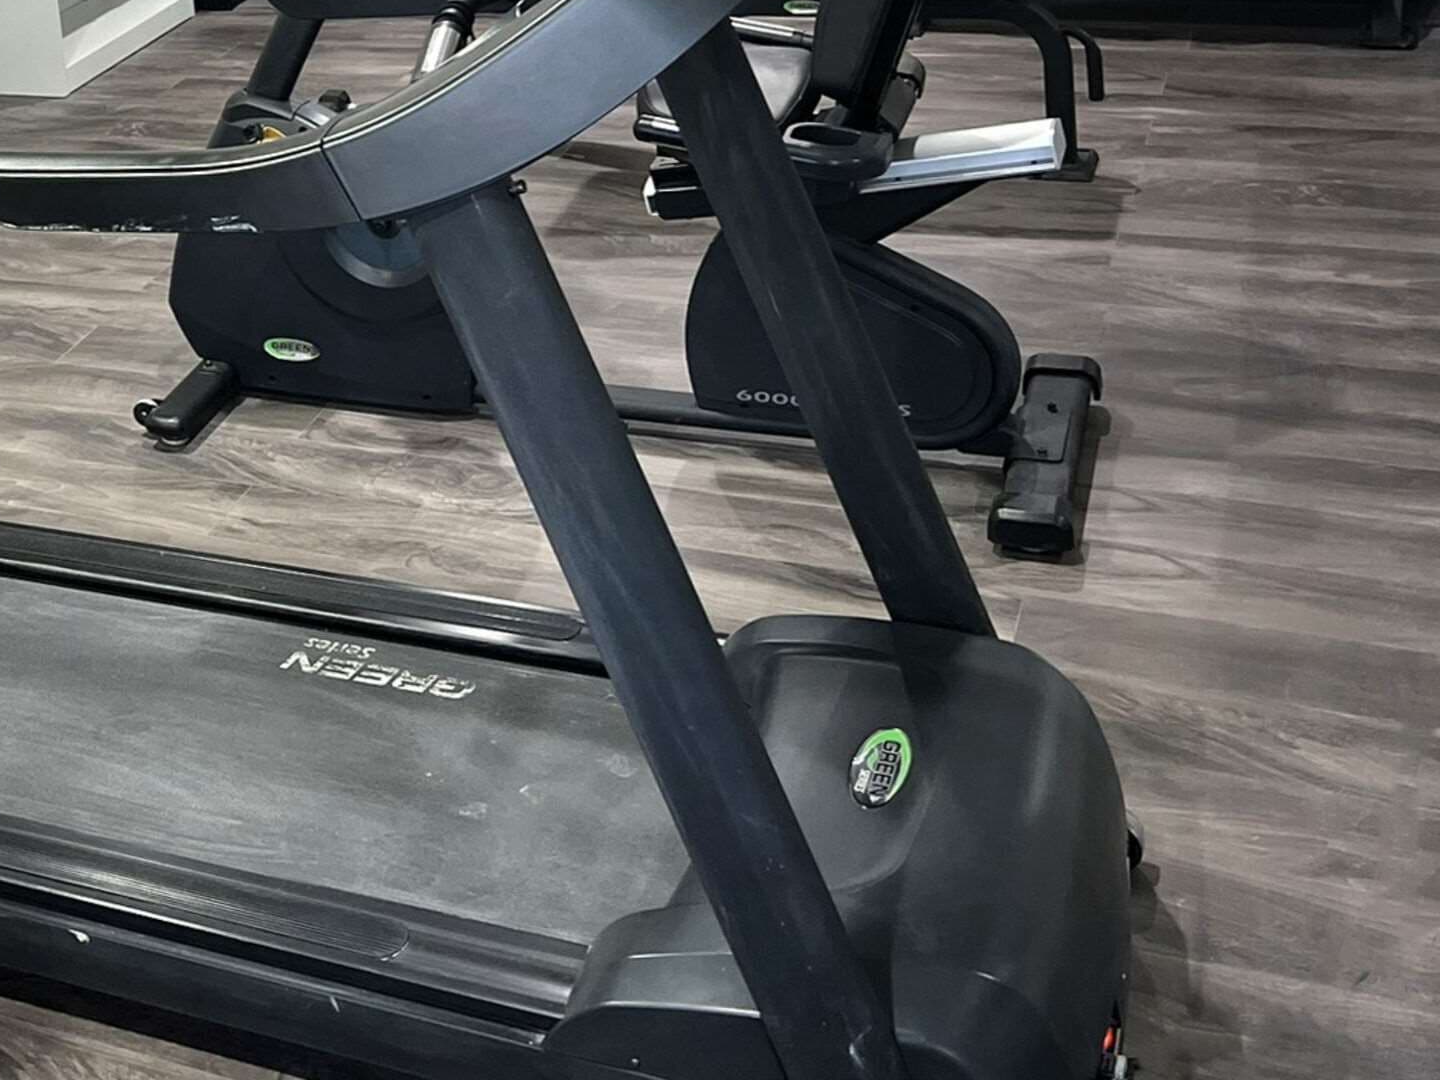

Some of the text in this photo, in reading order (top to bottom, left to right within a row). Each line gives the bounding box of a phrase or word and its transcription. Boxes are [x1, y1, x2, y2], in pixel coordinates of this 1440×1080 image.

[304, 637, 376, 659] Series
[279, 650, 477, 699] GREEN
[869, 740, 901, 797] GREEN
